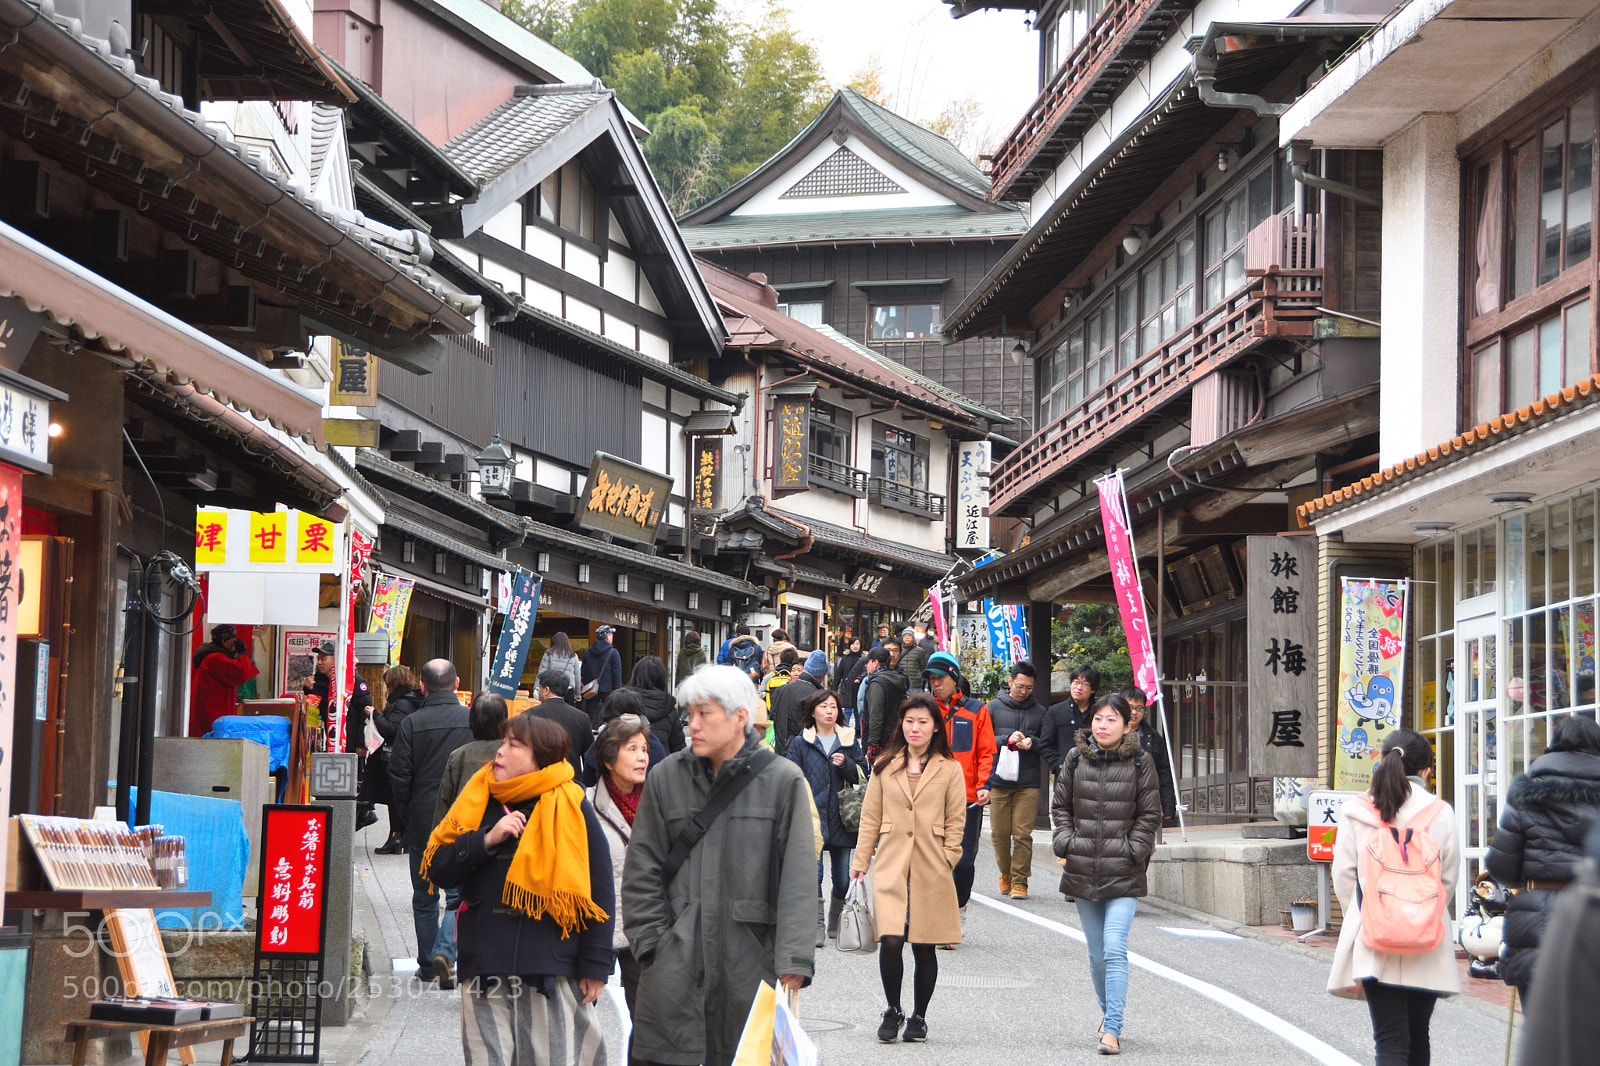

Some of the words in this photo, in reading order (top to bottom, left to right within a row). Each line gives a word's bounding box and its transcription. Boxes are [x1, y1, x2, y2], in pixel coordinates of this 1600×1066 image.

[781, 416, 805, 482] 近江屋
[960, 451, 973, 502] 天ぷら
[964, 505, 980, 545] 近江屋
[1322, 807, 1338, 824] 大
[300, 818, 321, 909] お箸にお名前
[269, 856, 293, 946] 無料彫刻
